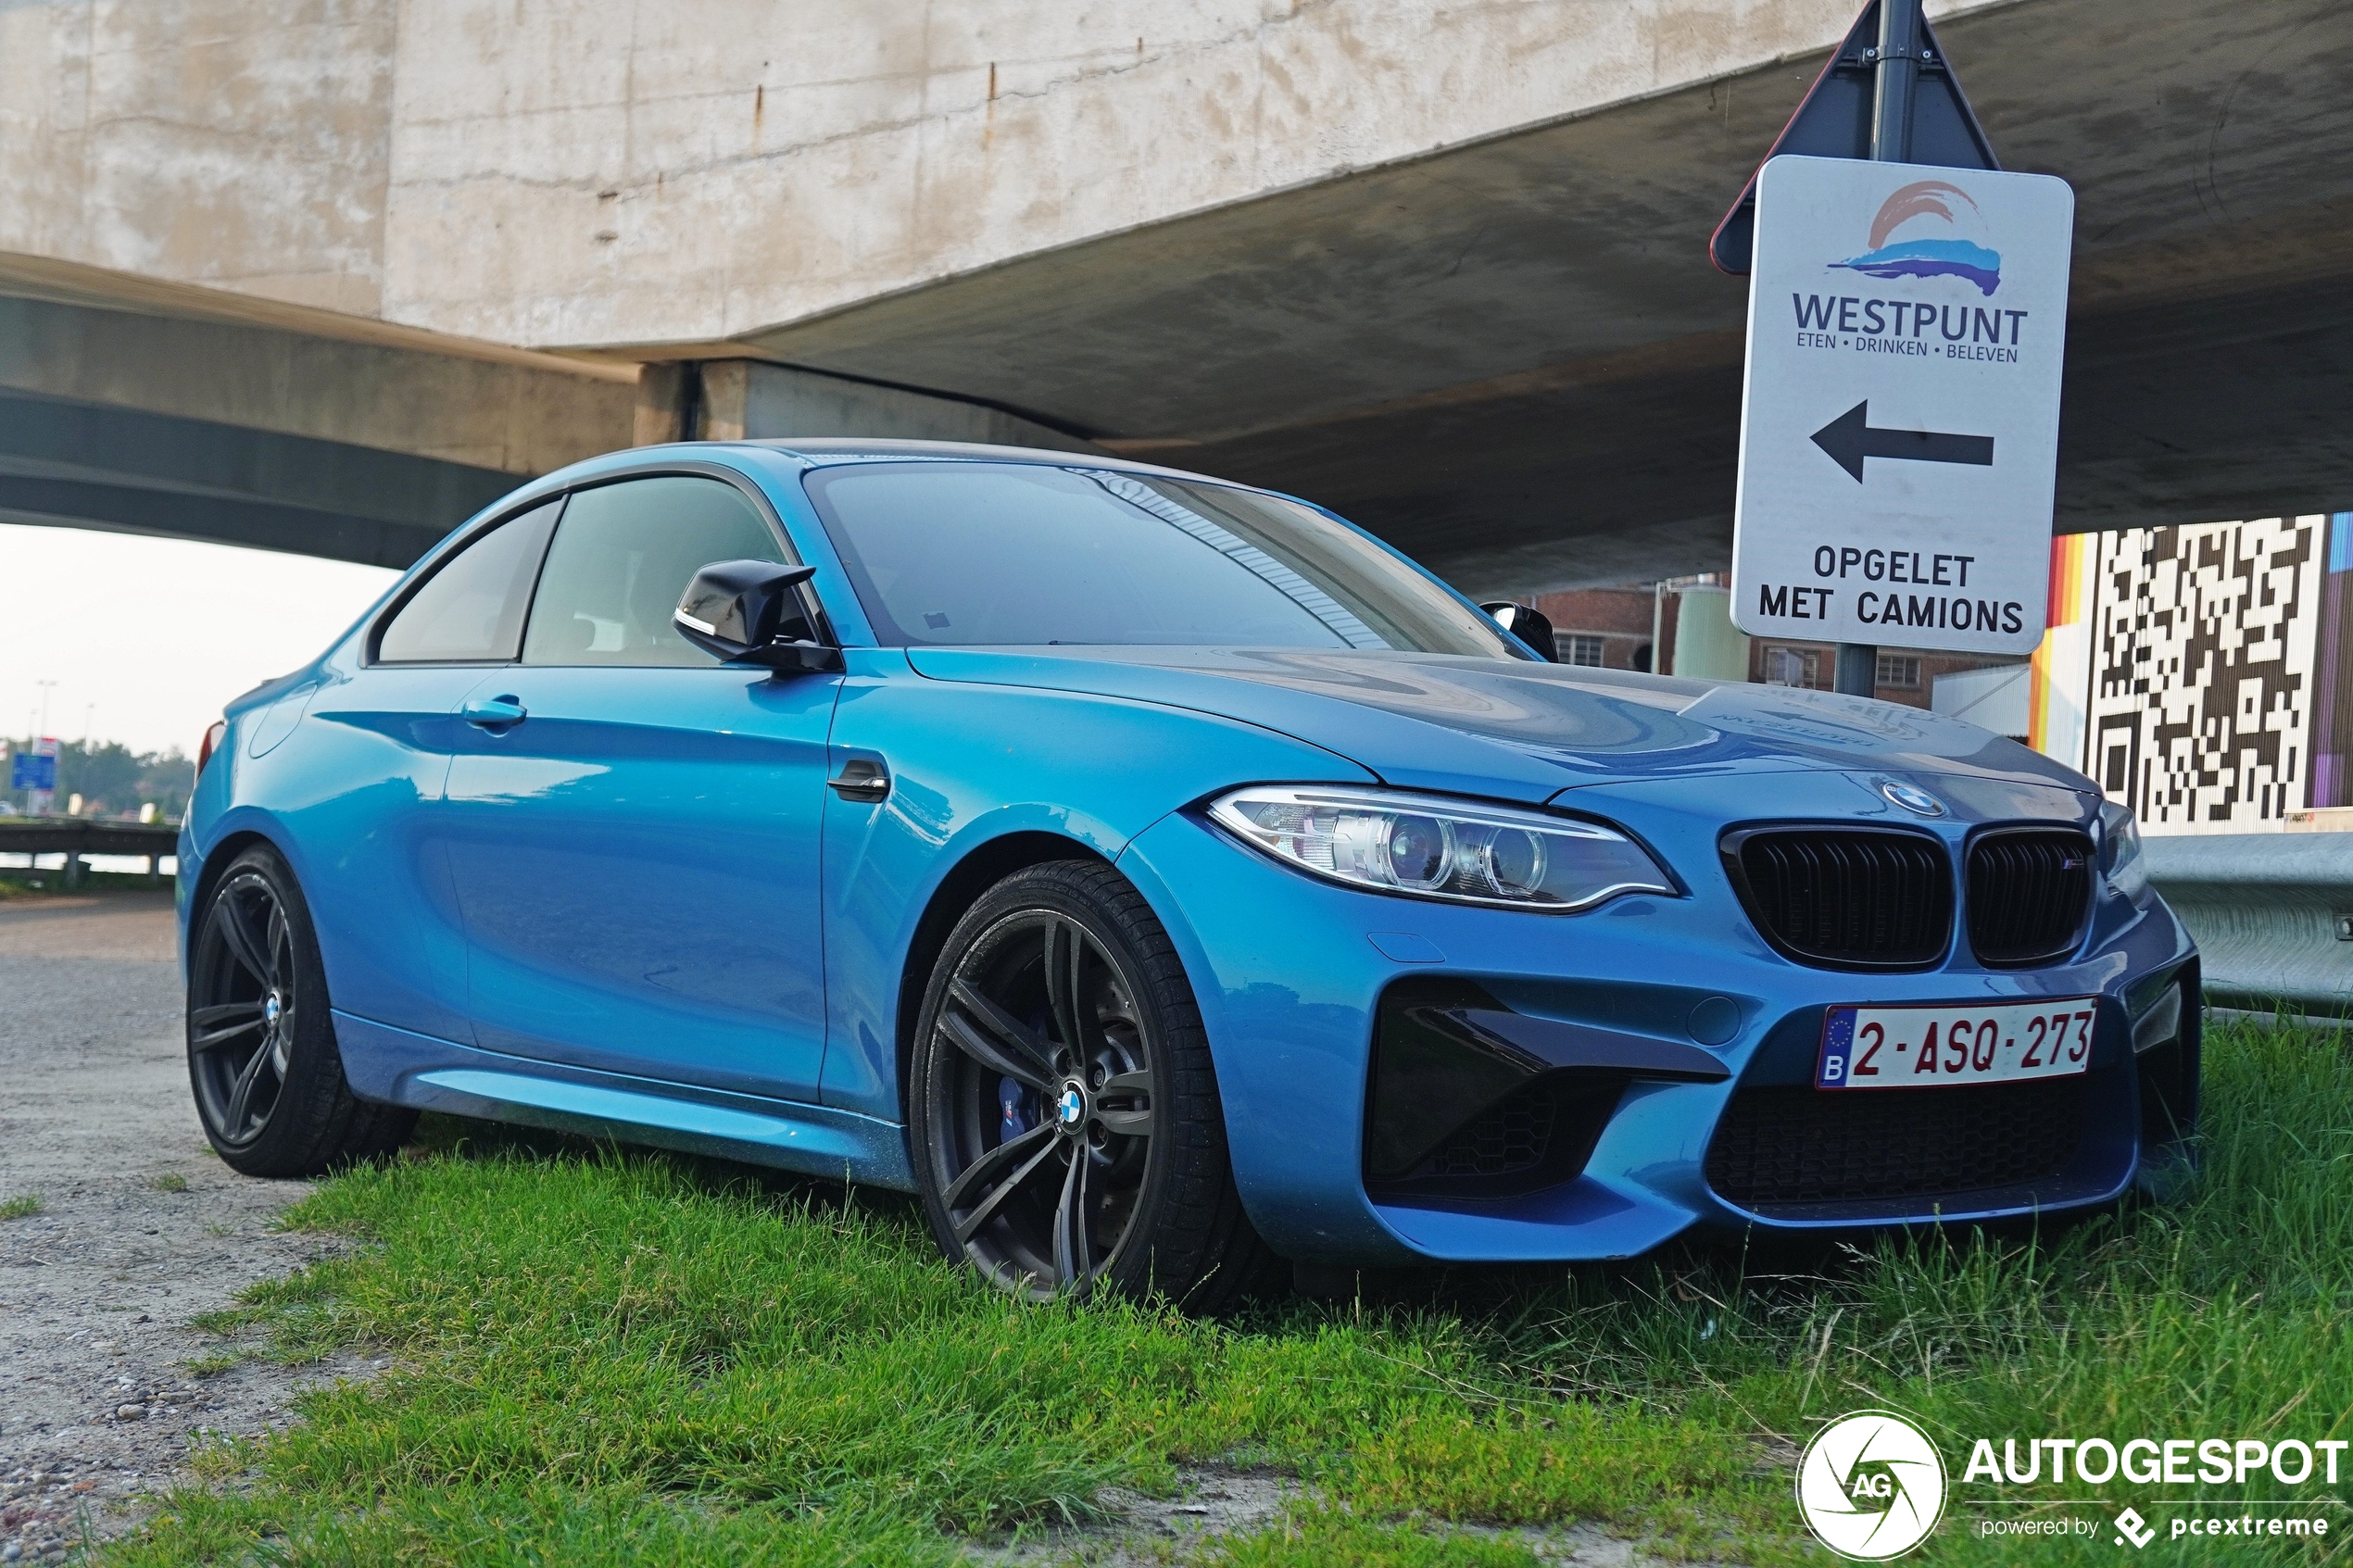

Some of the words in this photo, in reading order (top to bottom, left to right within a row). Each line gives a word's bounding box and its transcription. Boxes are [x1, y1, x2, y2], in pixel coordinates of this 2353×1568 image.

[1793, 293, 2028, 345] WESTPUNT
[1797, 332, 1836, 349] ETEN
[1856, 337, 1928, 356] DRINKEN
[1946, 345, 2018, 363] BELEVEN
[1814, 545, 1974, 587] OPGELET
[1759, 584, 1834, 621] MET
[1857, 591, 2023, 633] CAMIONS
[1823, 1056, 1843, 1081] B
[1854, 1010, 2092, 1076] 2-ASQ-273
